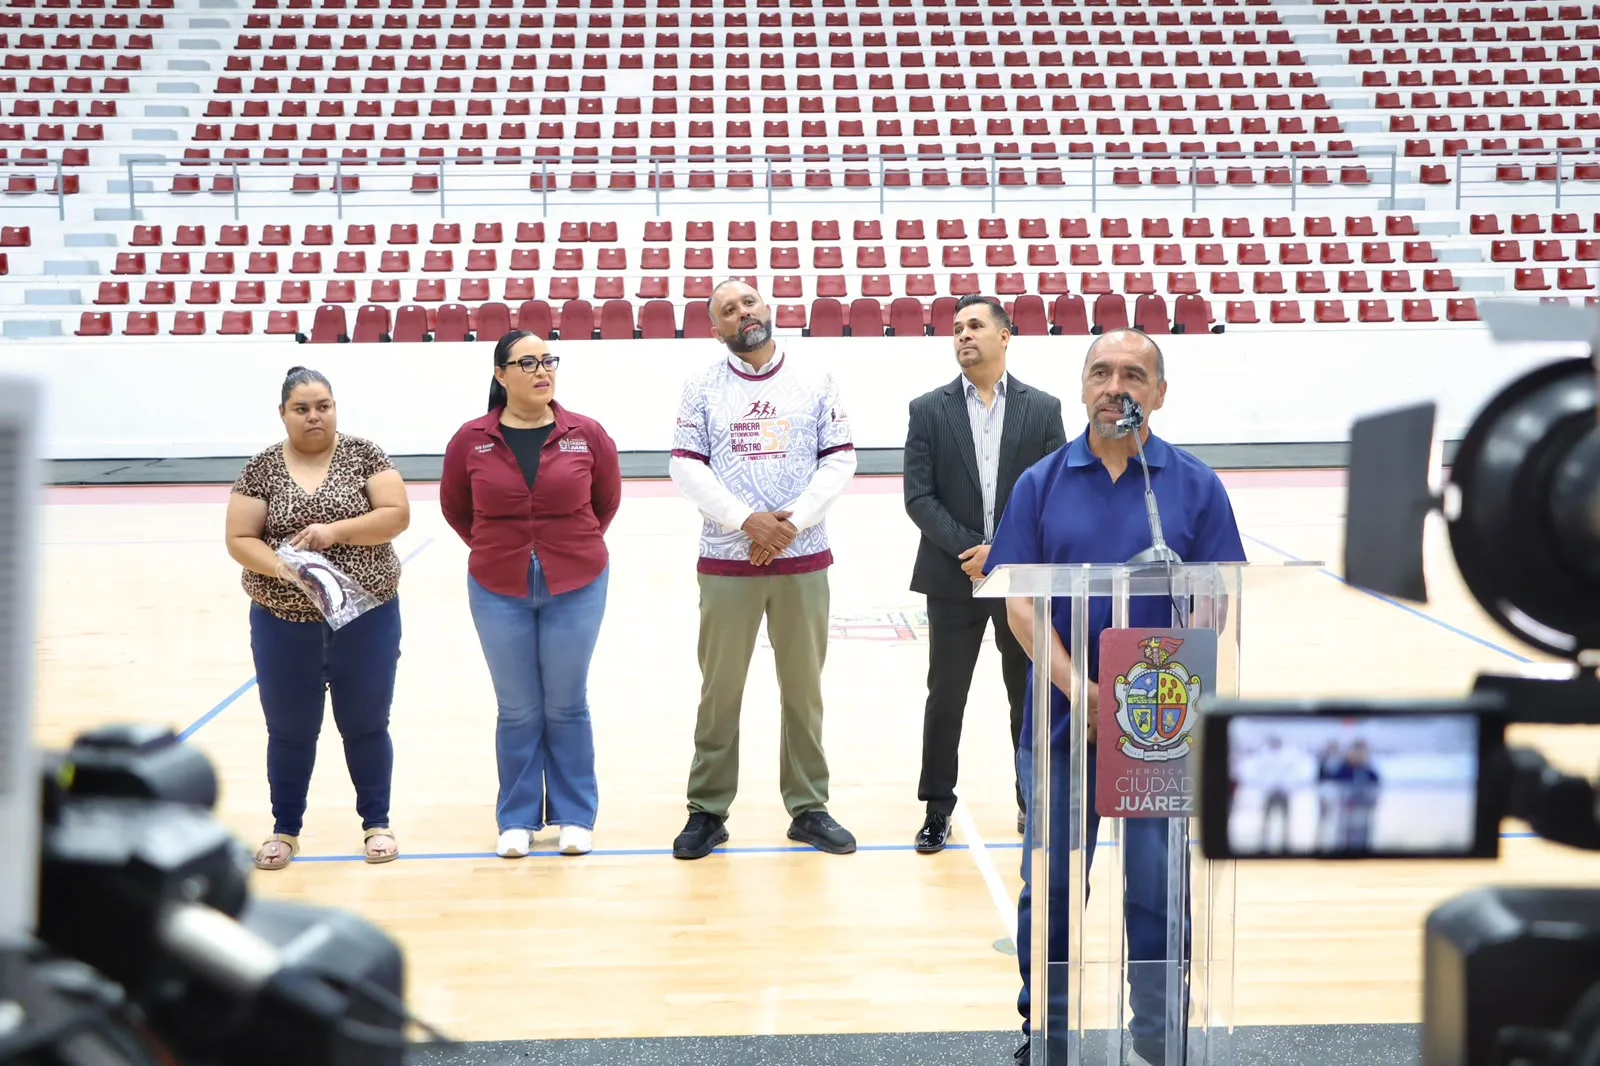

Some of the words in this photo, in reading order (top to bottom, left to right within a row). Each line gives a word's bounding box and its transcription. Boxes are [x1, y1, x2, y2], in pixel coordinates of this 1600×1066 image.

[730, 422, 760, 431] CARRERA
[761, 420, 790, 451] 57
[732, 442, 762, 452] AMISTAD
[1115, 776, 1195, 793] CIUDAD
[1114, 791, 1194, 812] JUÁREZ
